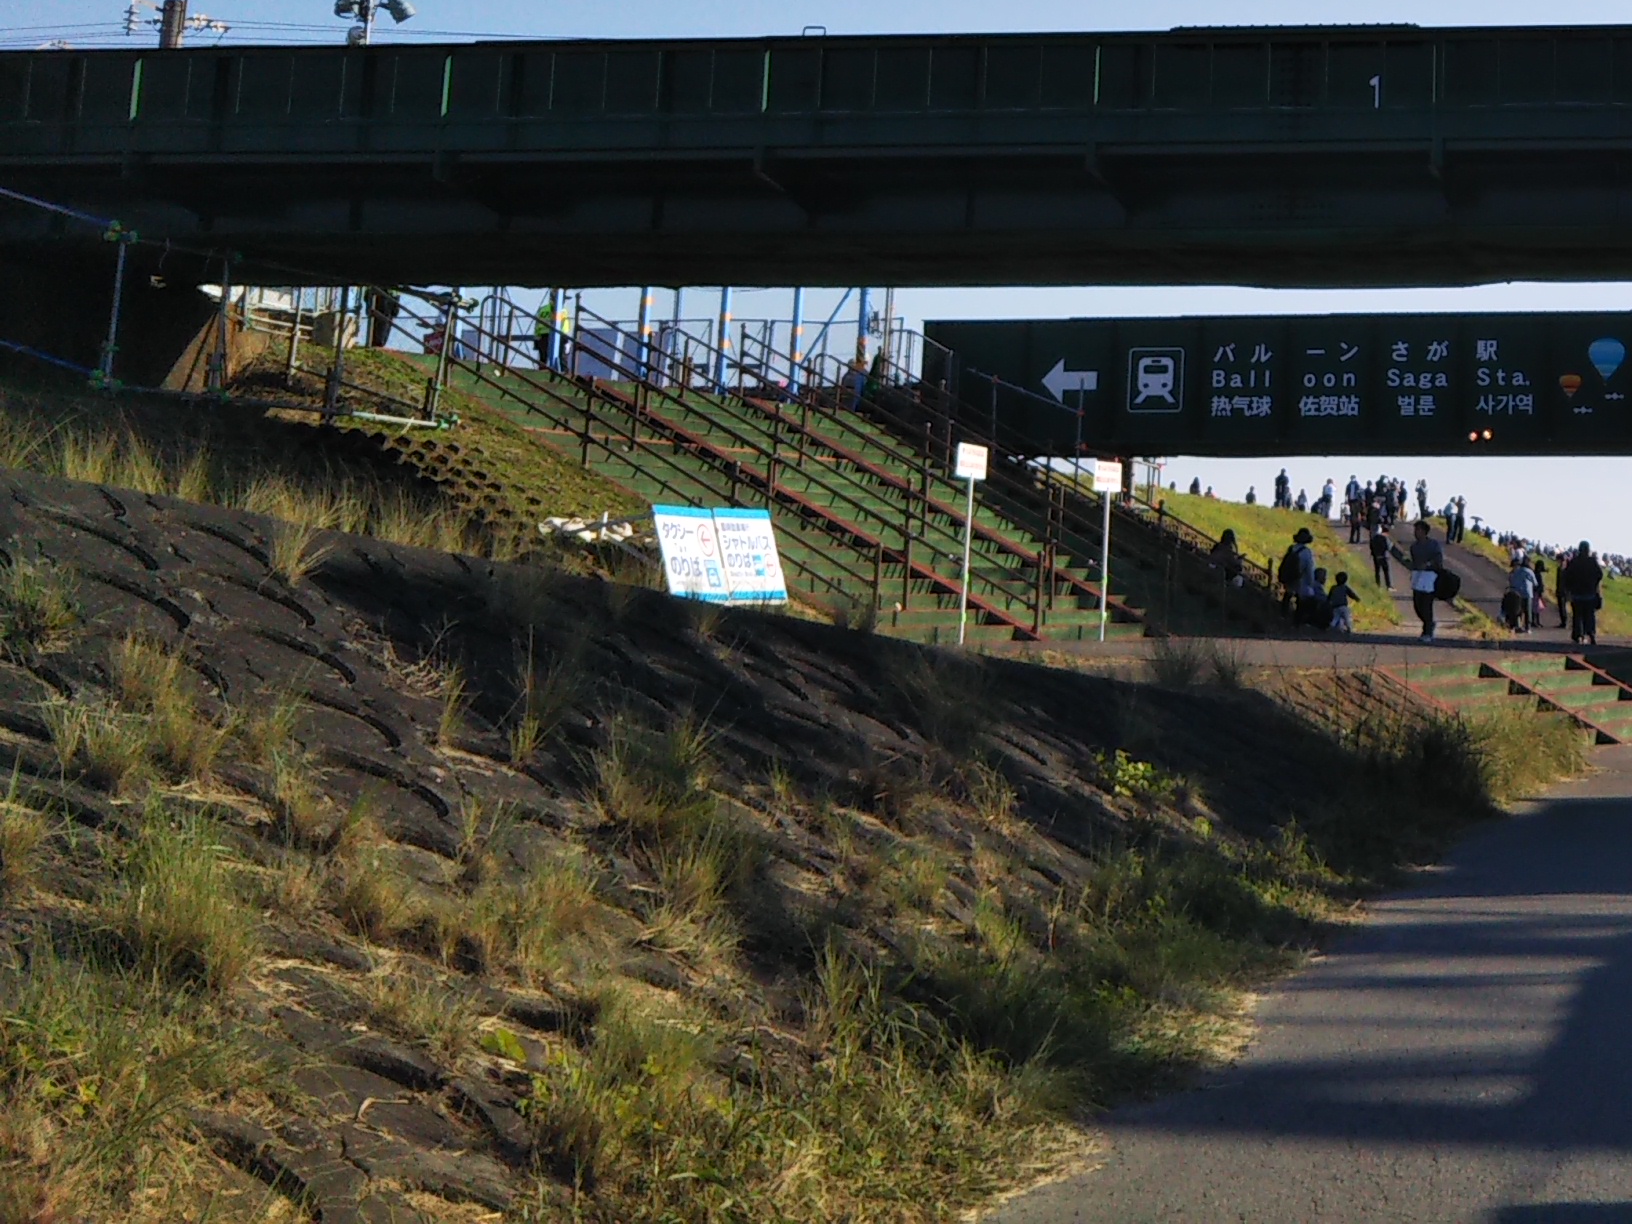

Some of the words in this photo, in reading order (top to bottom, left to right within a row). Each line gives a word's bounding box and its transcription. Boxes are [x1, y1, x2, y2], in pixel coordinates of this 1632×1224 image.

[1369, 75, 1381, 109] 1
[1386, 368, 1448, 389] Saga
[662, 521, 694, 540] タクシー
[722, 534, 772, 551] シャトルバス
[670, 555, 703, 578] のりば
[727, 552, 752, 569] のりば
